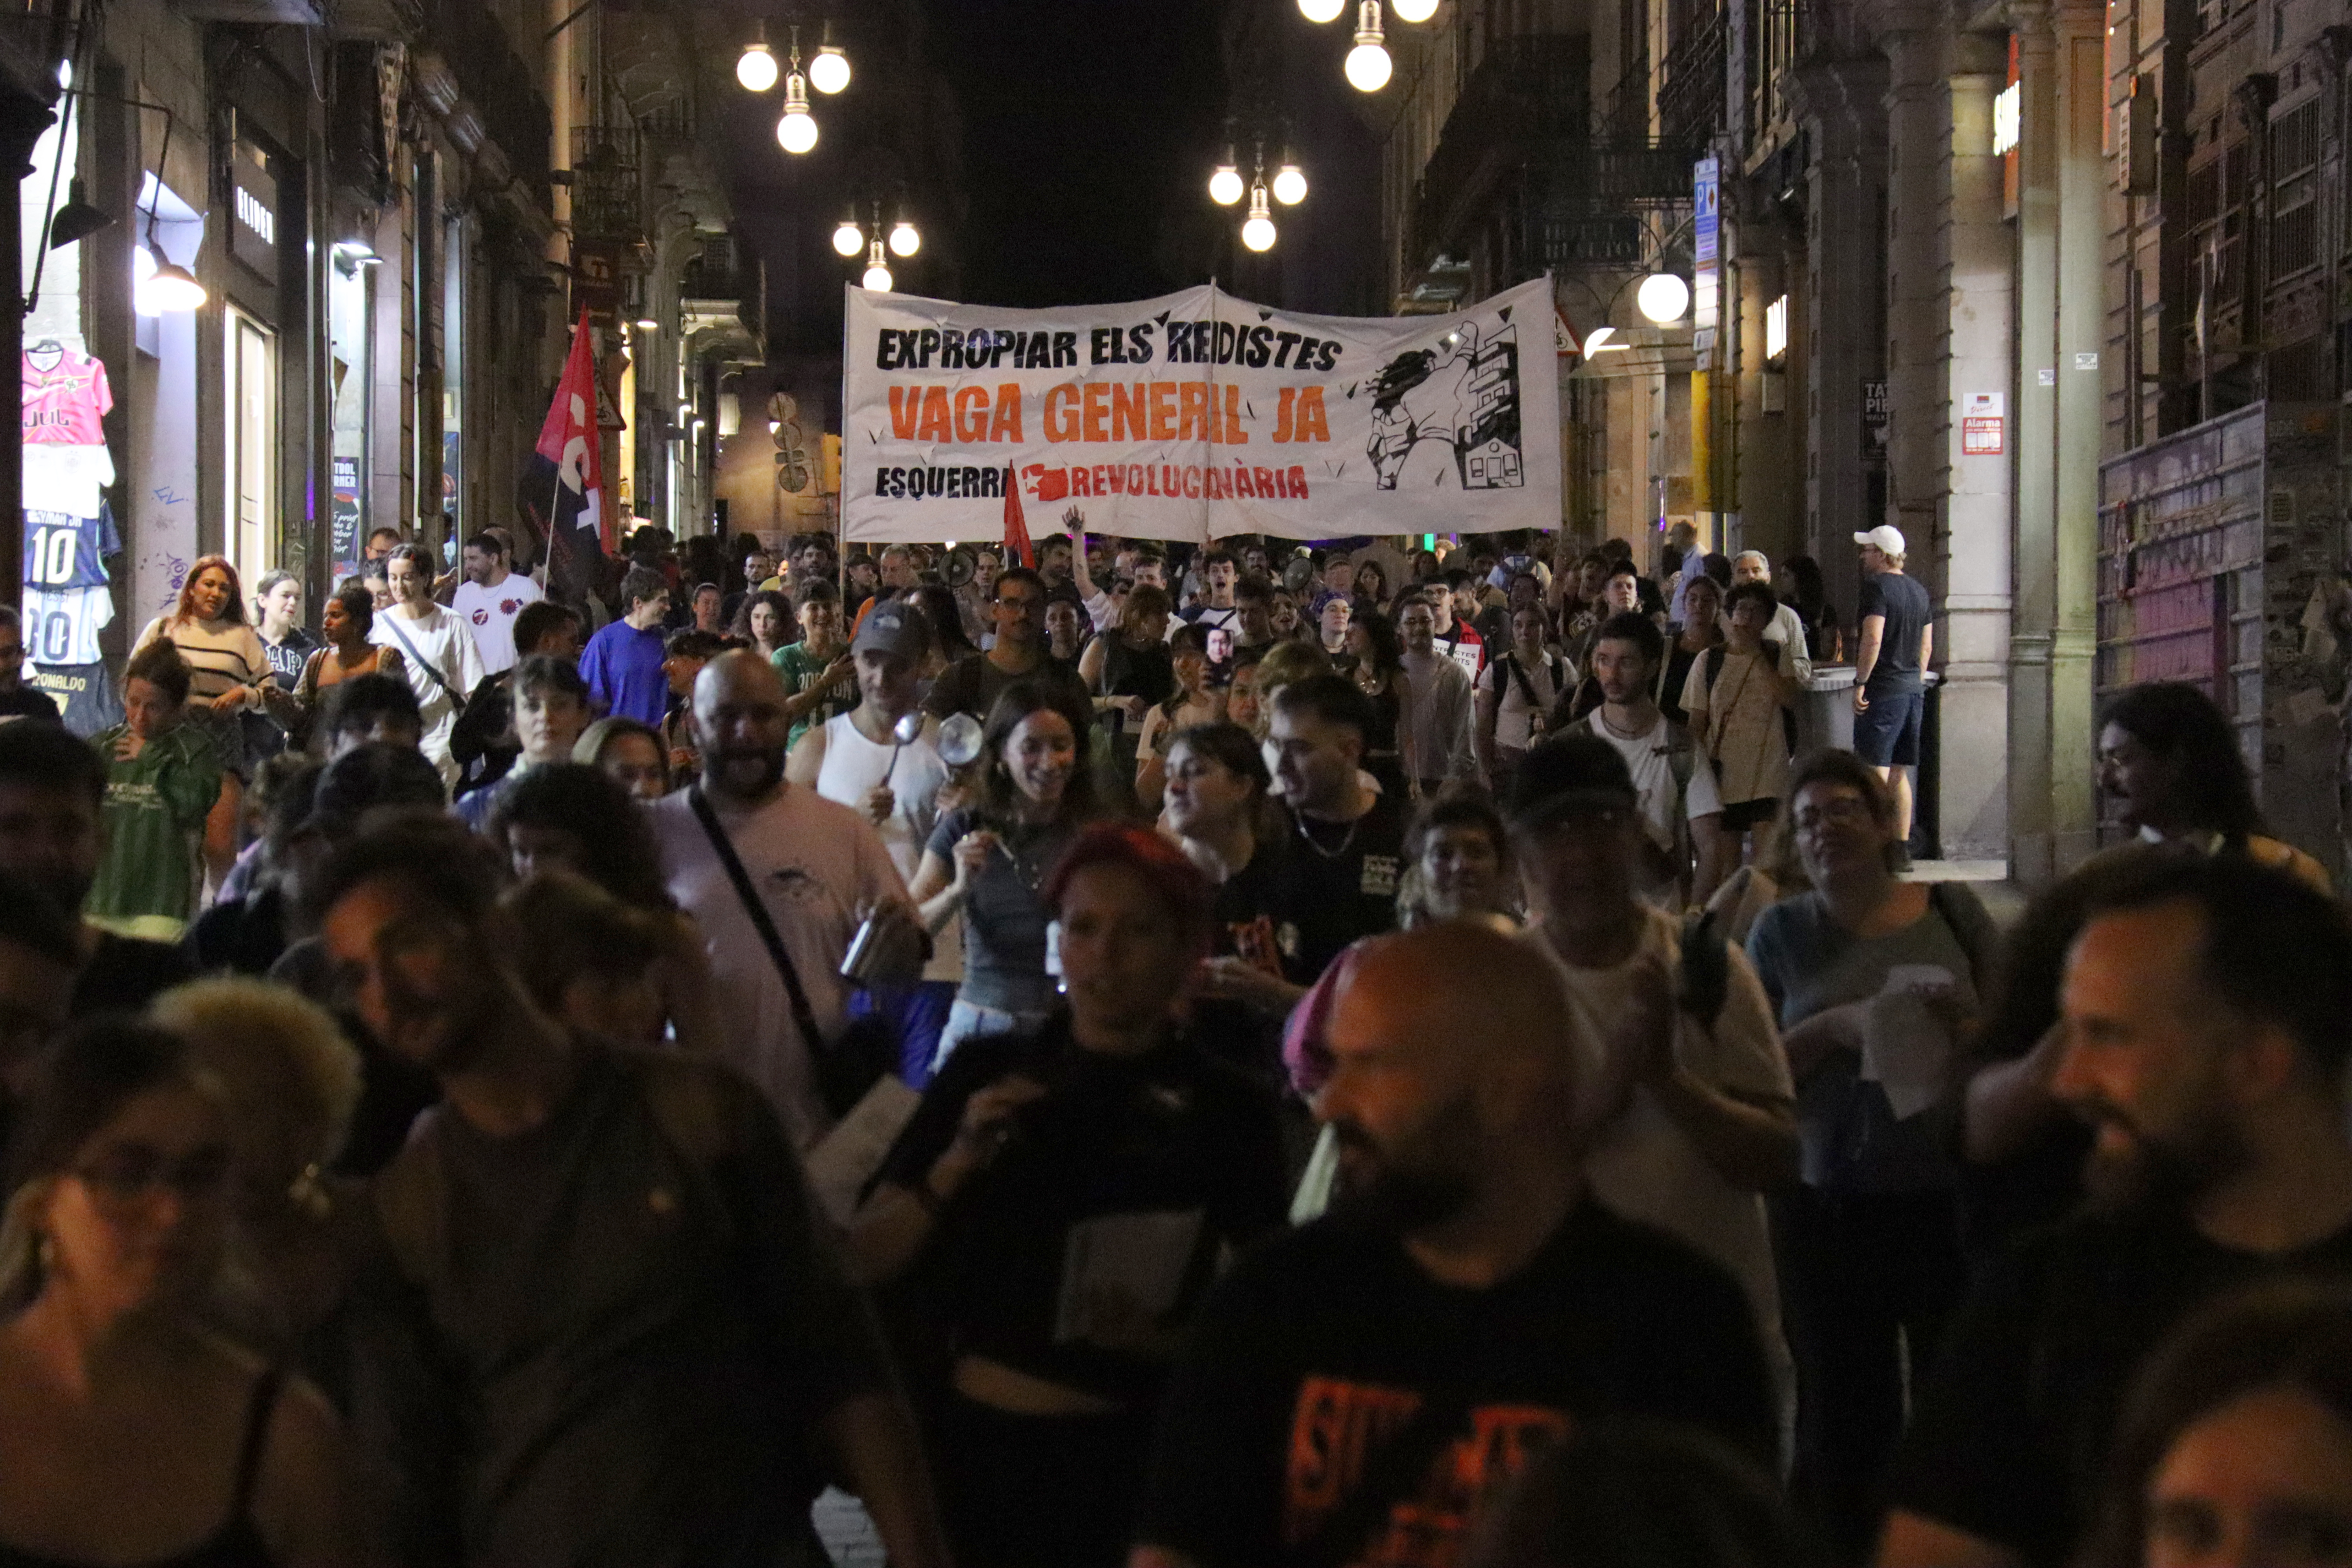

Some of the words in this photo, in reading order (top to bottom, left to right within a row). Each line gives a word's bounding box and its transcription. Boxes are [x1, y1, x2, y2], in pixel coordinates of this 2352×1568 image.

[1697, 184, 1704, 214] P
[877, 328, 1078, 371] EXPROPIAR
[1091, 323, 1153, 365] ELS
[24, 409, 69, 427] JUL
[888, 383, 1024, 444] VAGA
[1272, 385, 1331, 444] JA
[1966, 418, 2001, 427] Alarma
[31, 526, 77, 584] 10
[29, 607, 71, 661] 10
[31, 673, 86, 692] RONALDO
